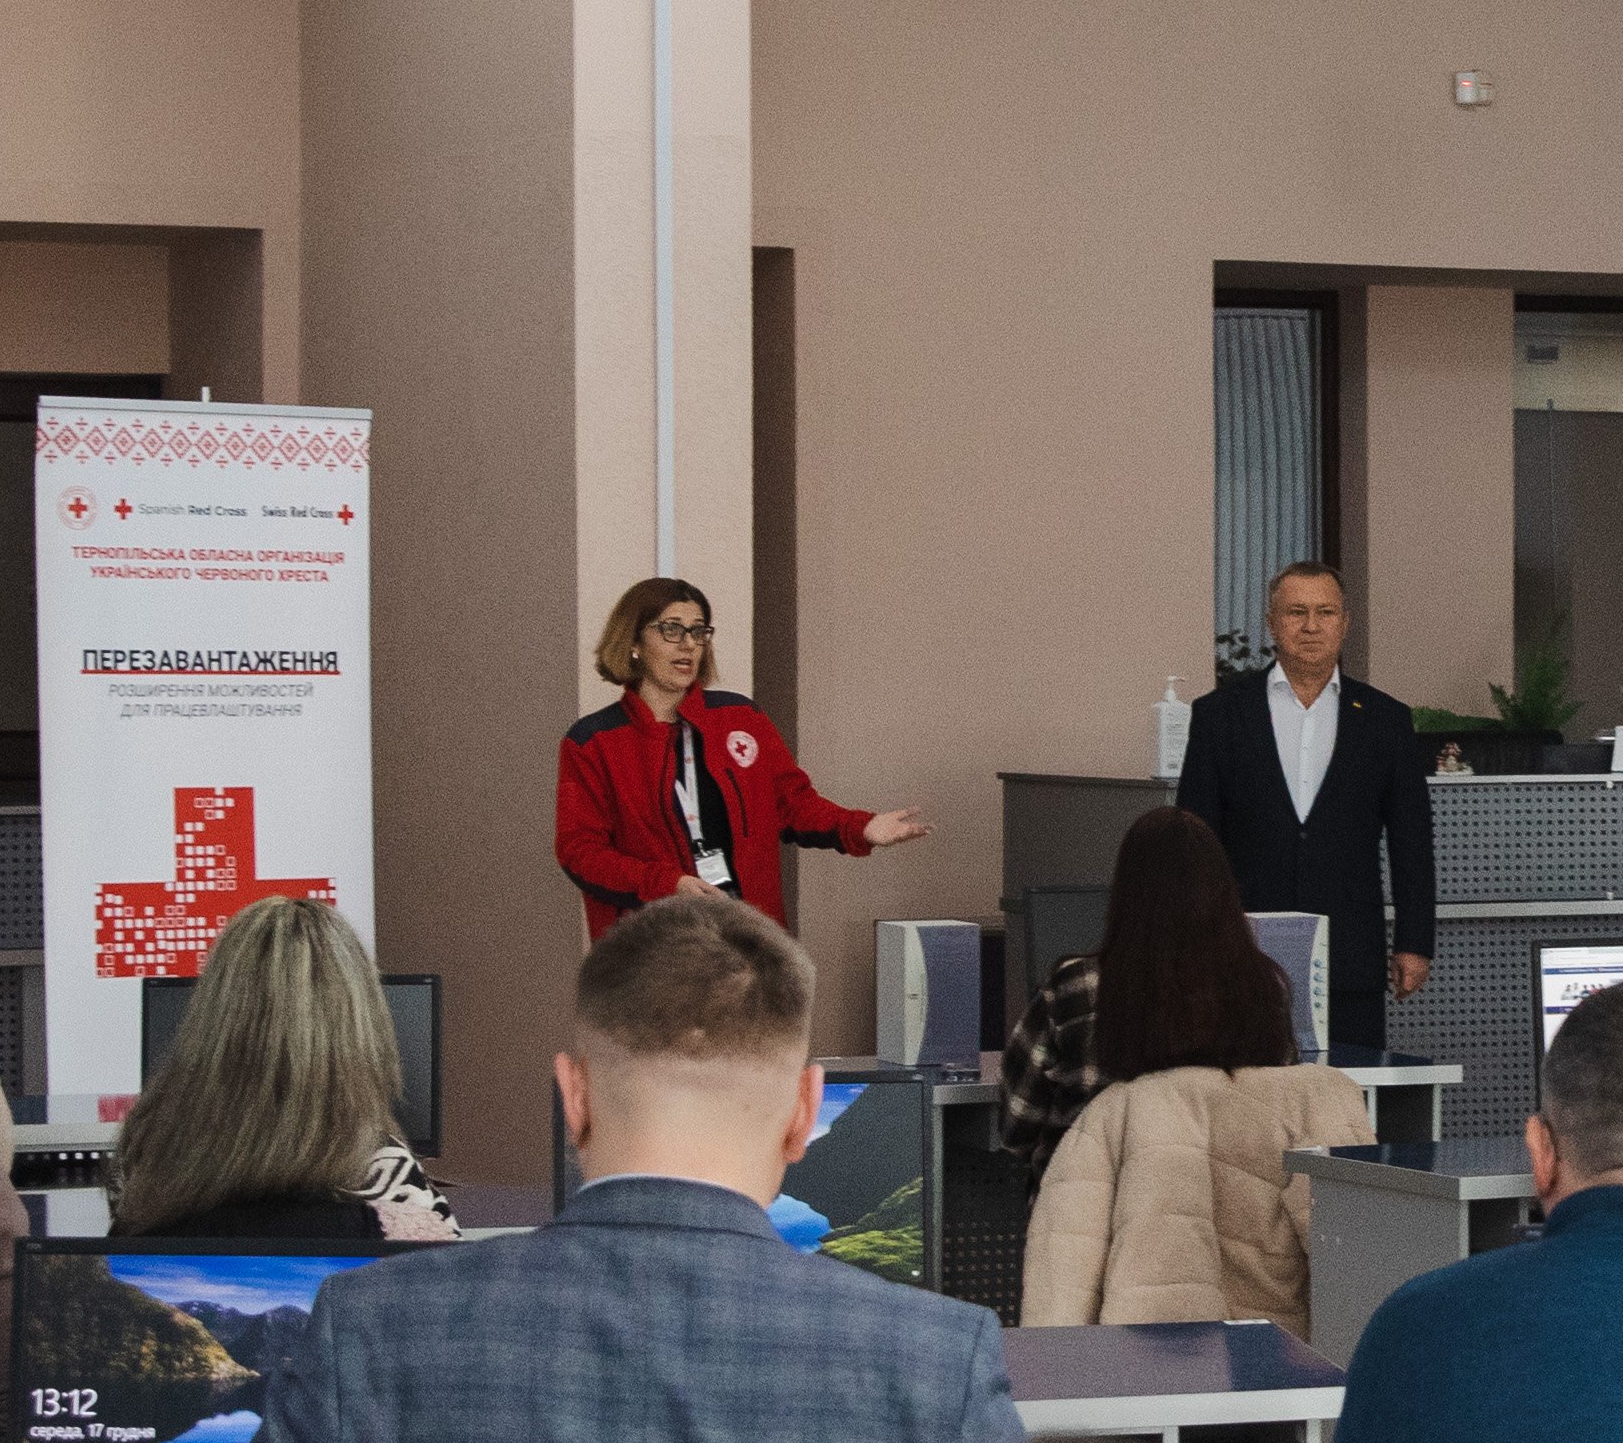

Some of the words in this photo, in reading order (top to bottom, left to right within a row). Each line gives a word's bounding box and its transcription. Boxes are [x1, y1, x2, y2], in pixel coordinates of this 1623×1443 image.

[188, 505, 211, 516] Red
[216, 505, 246, 517] Cross
[72, 546, 185, 561] ТЕРНОПІЛЬСЬКА
[190, 548, 253, 563] ОБЛАСНА
[257, 550, 345, 565] ОРГАНІЗАЦІЯ
[91, 564, 191, 579] УКРАЇНСЬКОГО
[195, 567, 273, 582] ЧЕРВОНОГО
[277, 569, 328, 583] ХРЕСТА
[82, 649, 338, 672] ПЕРЕЗАВАНТАЖЕННЯ
[108, 684, 204, 698] РОЗШИРЕННЯ
[208, 682, 314, 698] МОЖЛИВОСТЕЙ
[120, 704, 150, 718] ДЛЯ
[31, 1388, 98, 1416] 13:12
[87, 1423, 105, 1438] 17
[106, 1427, 156, 1442] грудня
